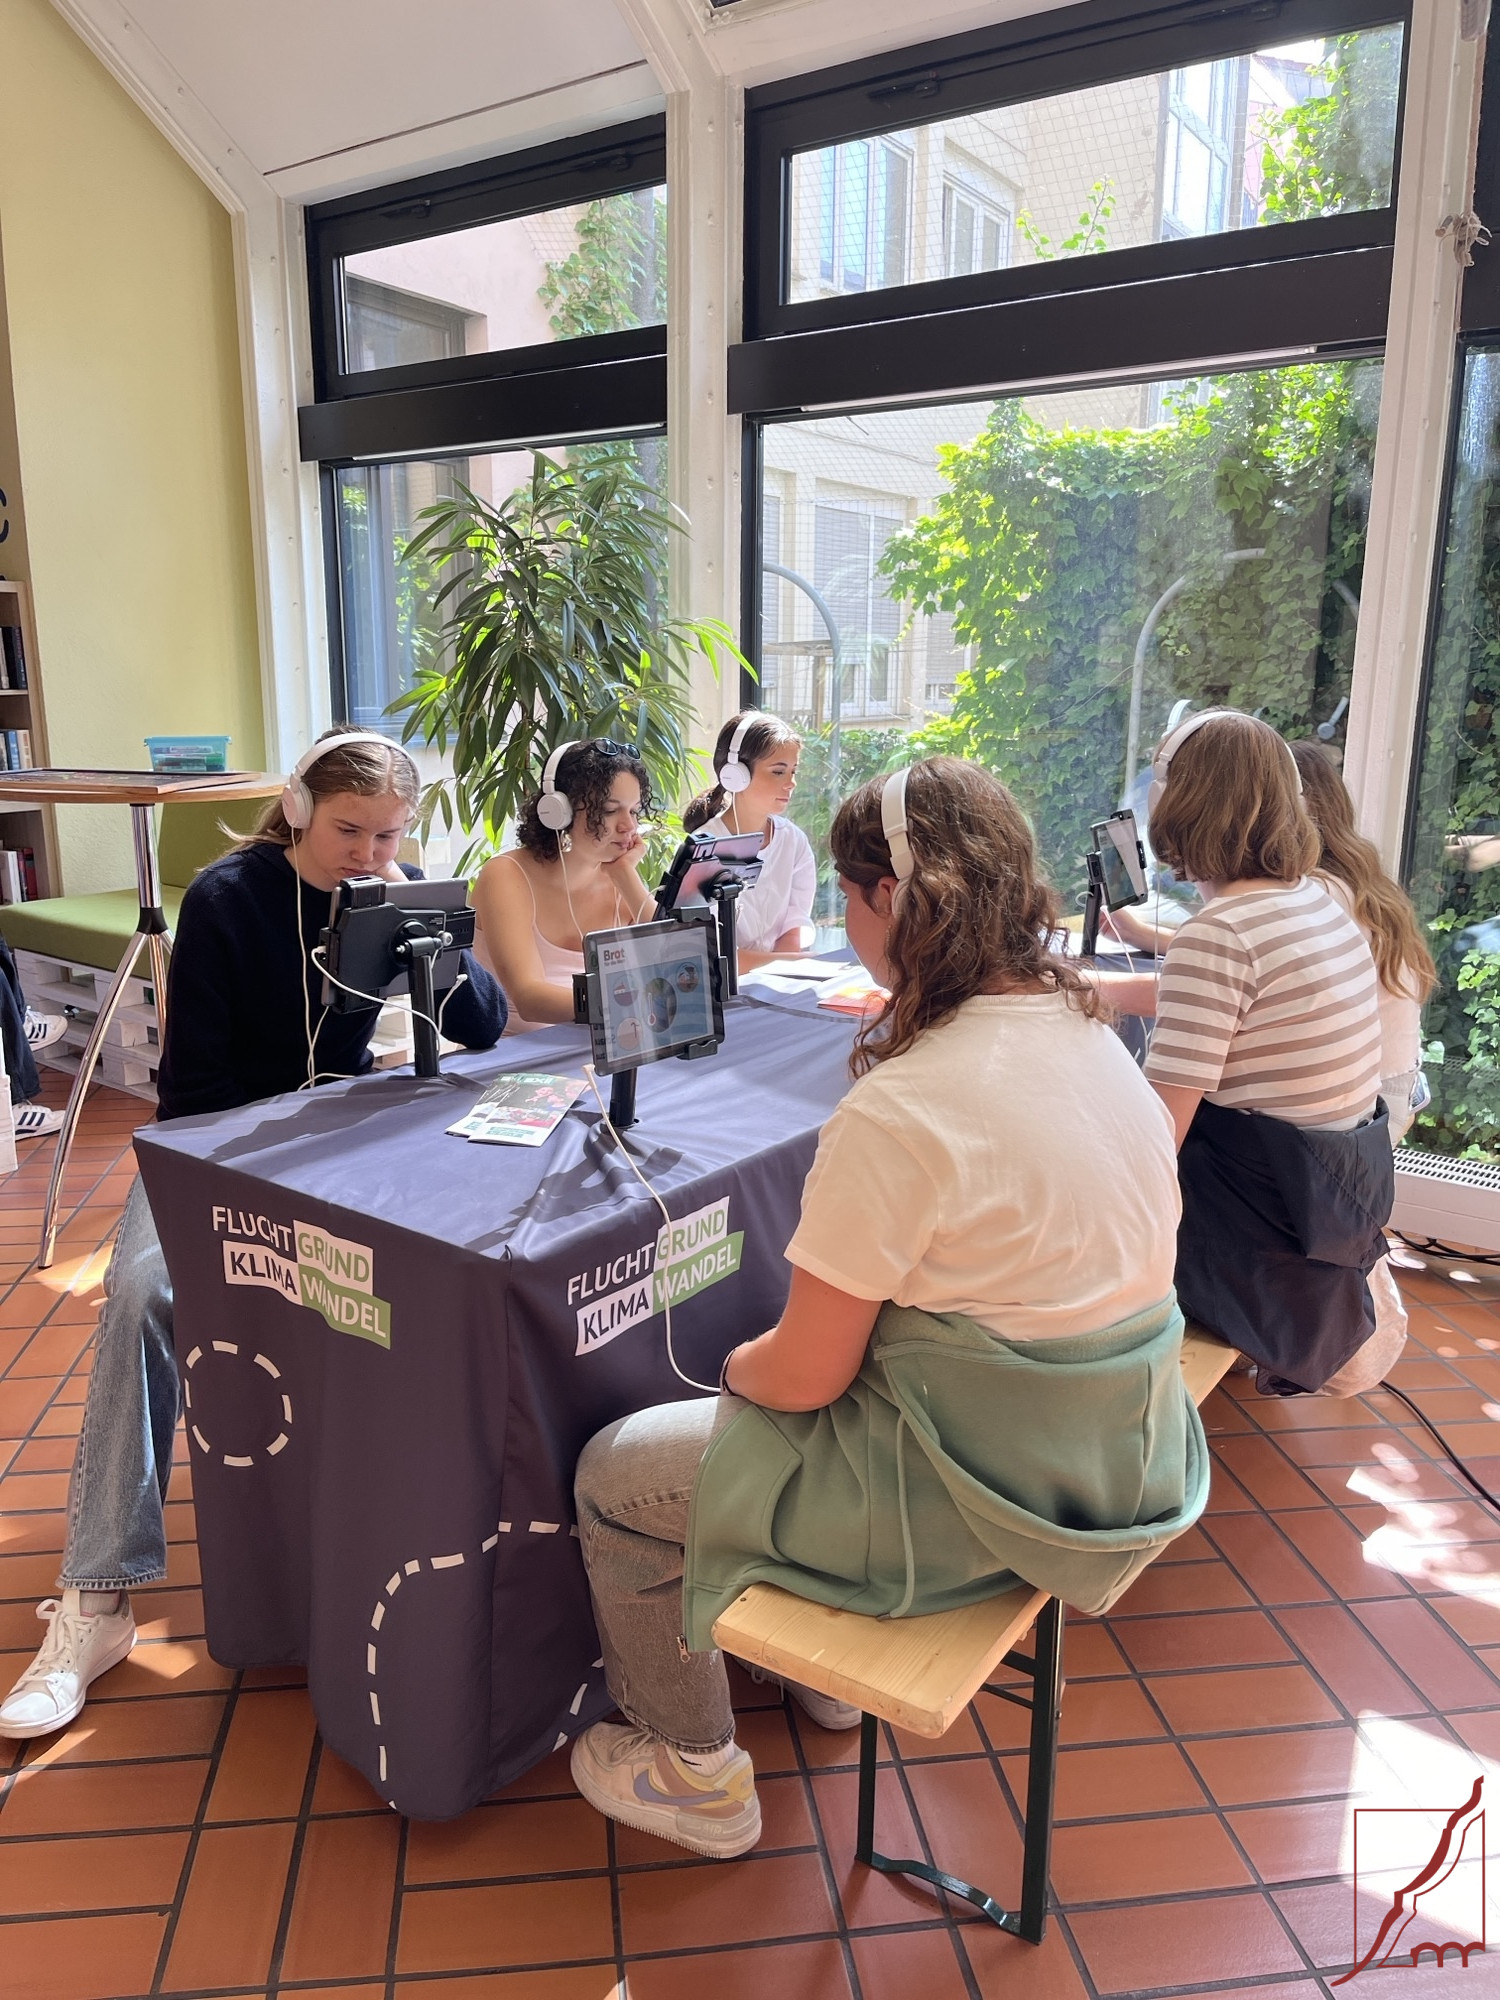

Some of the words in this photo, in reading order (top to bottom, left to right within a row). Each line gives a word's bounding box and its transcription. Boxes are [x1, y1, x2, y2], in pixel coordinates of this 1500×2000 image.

[604, 947, 625, 961] Brot
[212, 1206, 292, 1251] FLUCHT
[298, 1231, 370, 1283] GRUND
[568, 1241, 655, 1306] FLUCHT
[657, 1209, 725, 1261] GRUND
[231, 1251, 297, 1296] KLIMA
[301, 1273, 387, 1338] WANDEL
[584, 1287, 650, 1345] KLIMA
[657, 1244, 736, 1304] WANDEL
